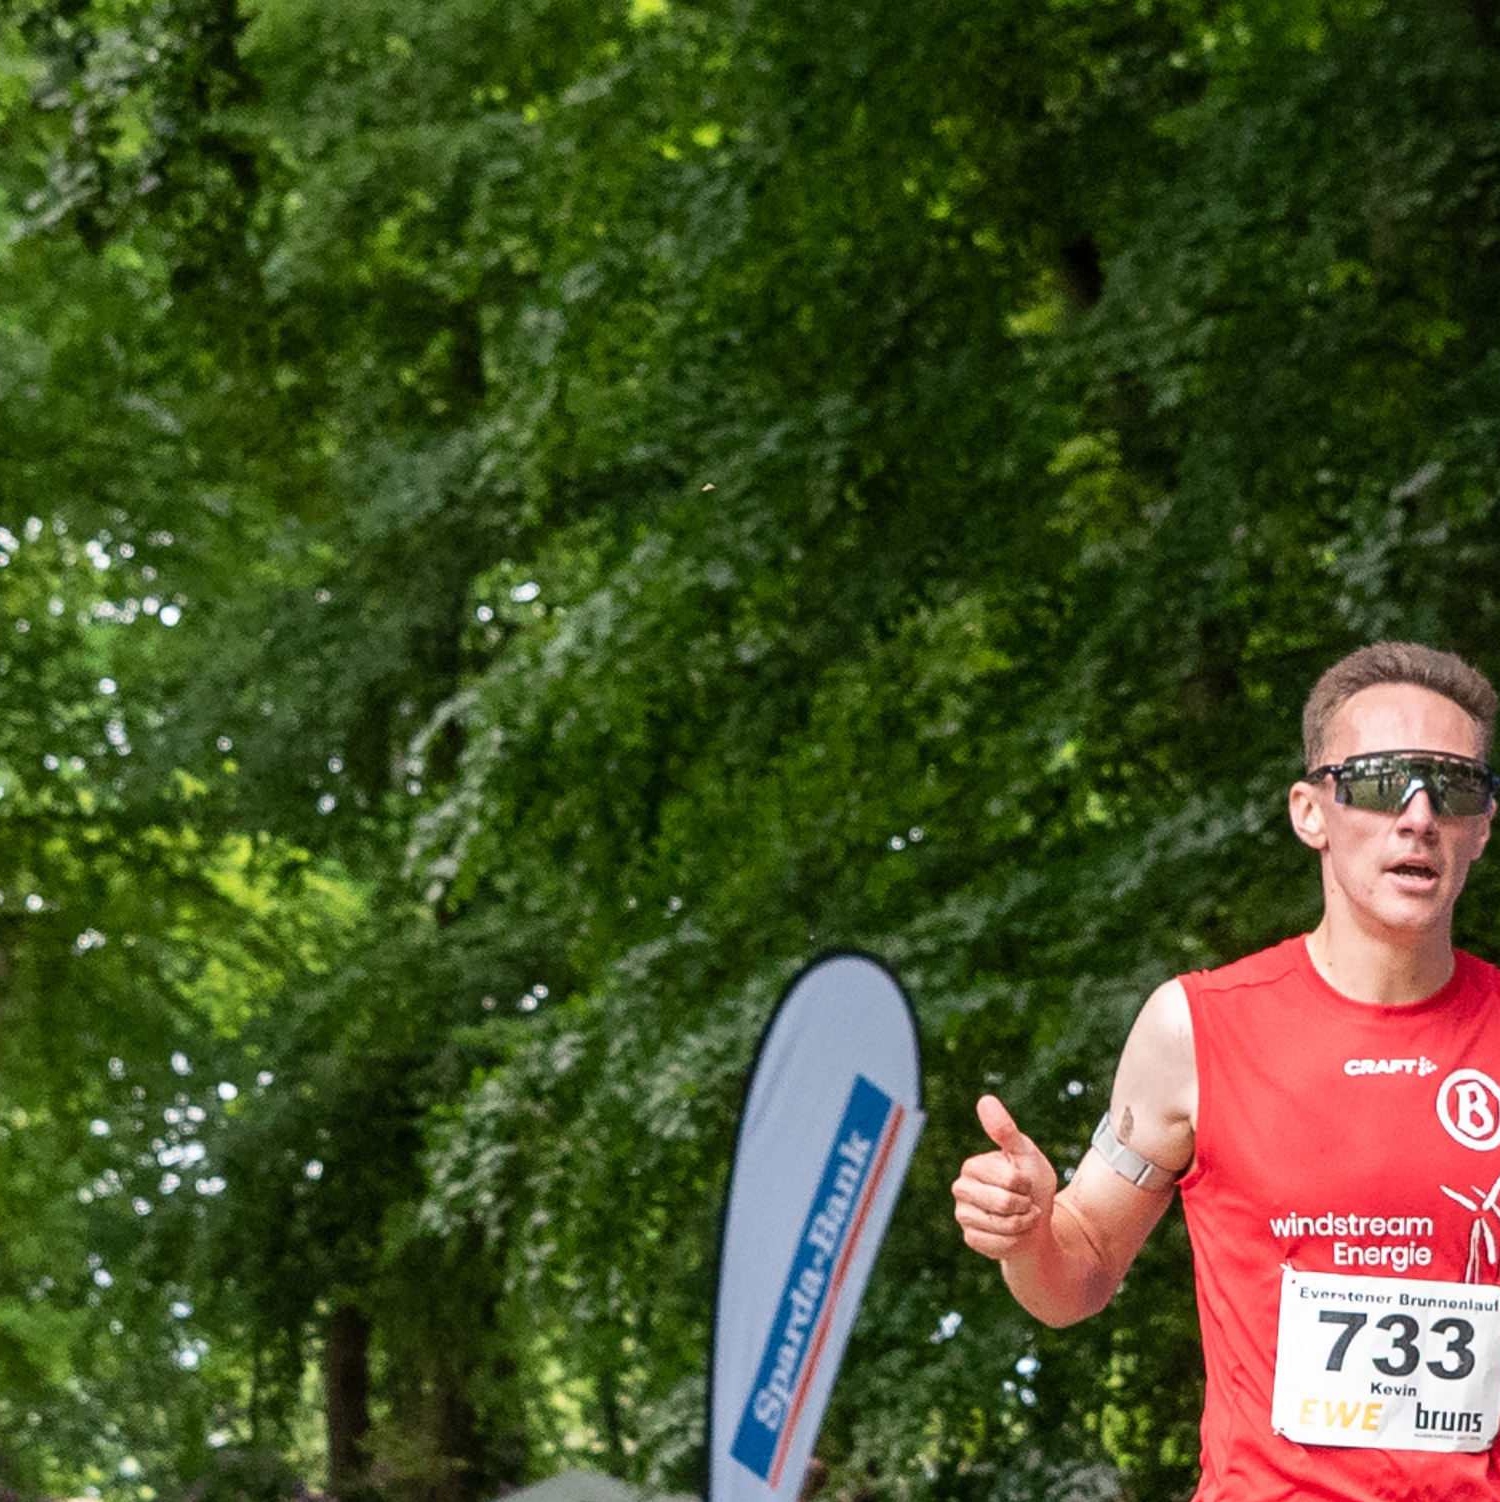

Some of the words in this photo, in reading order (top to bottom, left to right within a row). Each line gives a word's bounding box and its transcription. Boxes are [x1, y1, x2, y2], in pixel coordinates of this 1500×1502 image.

[1344, 1058, 1418, 1077] CRAFT
[1269, 1212, 1434, 1238] windstream
[1333, 1241, 1432, 1272] Energie
[753, 1129, 873, 1433] Sparda-Bank
[1299, 1286, 1393, 1305] Everstener
[1398, 1293, 1499, 1312] Brunnenlauf
[1318, 1309, 1476, 1381] 733
[1369, 1381, 1418, 1398] Kevin
[1299, 1398, 1383, 1432] EWE
[1415, 1401, 1484, 1433] bruns
